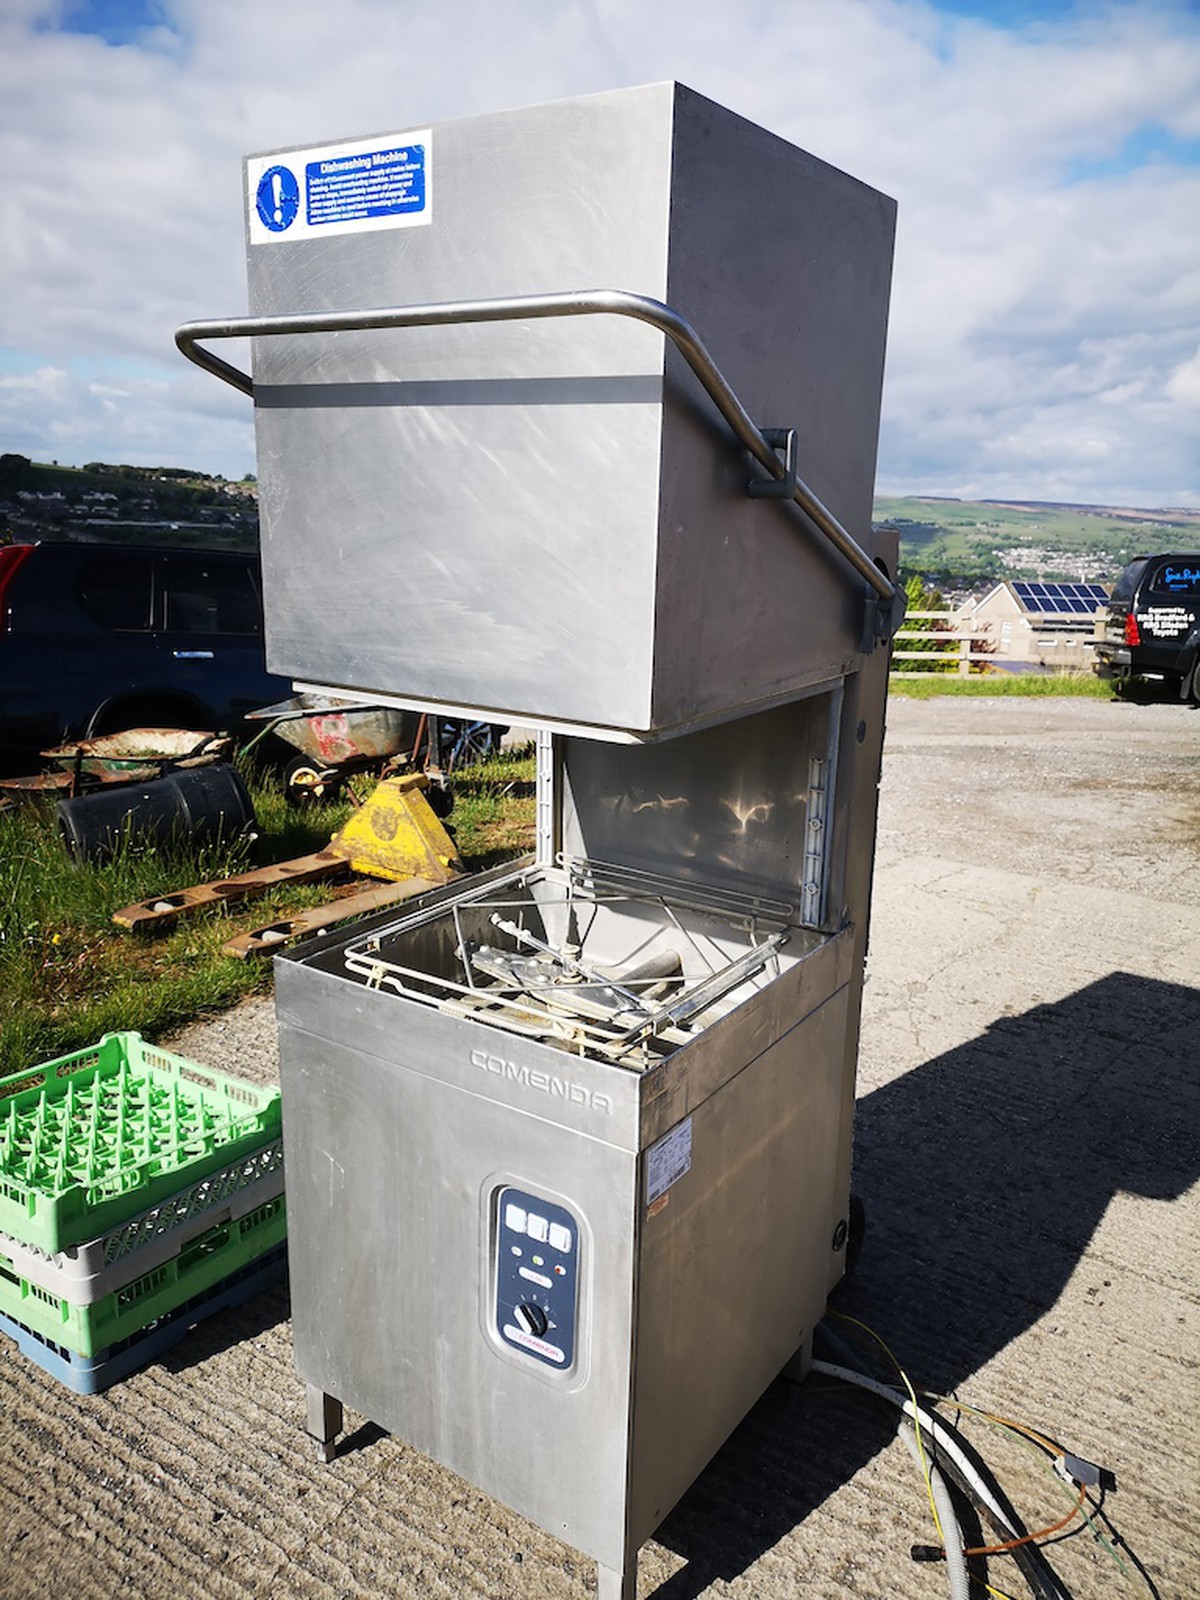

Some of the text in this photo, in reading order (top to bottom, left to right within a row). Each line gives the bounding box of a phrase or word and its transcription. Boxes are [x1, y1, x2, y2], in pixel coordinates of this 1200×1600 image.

[320, 151, 408, 174] Dishwashing Machine
[1165, 567, 1183, 583] Sue
[1152, 629, 1178, 637] Toyota
[470, 1049, 613, 1115] COMENDA
